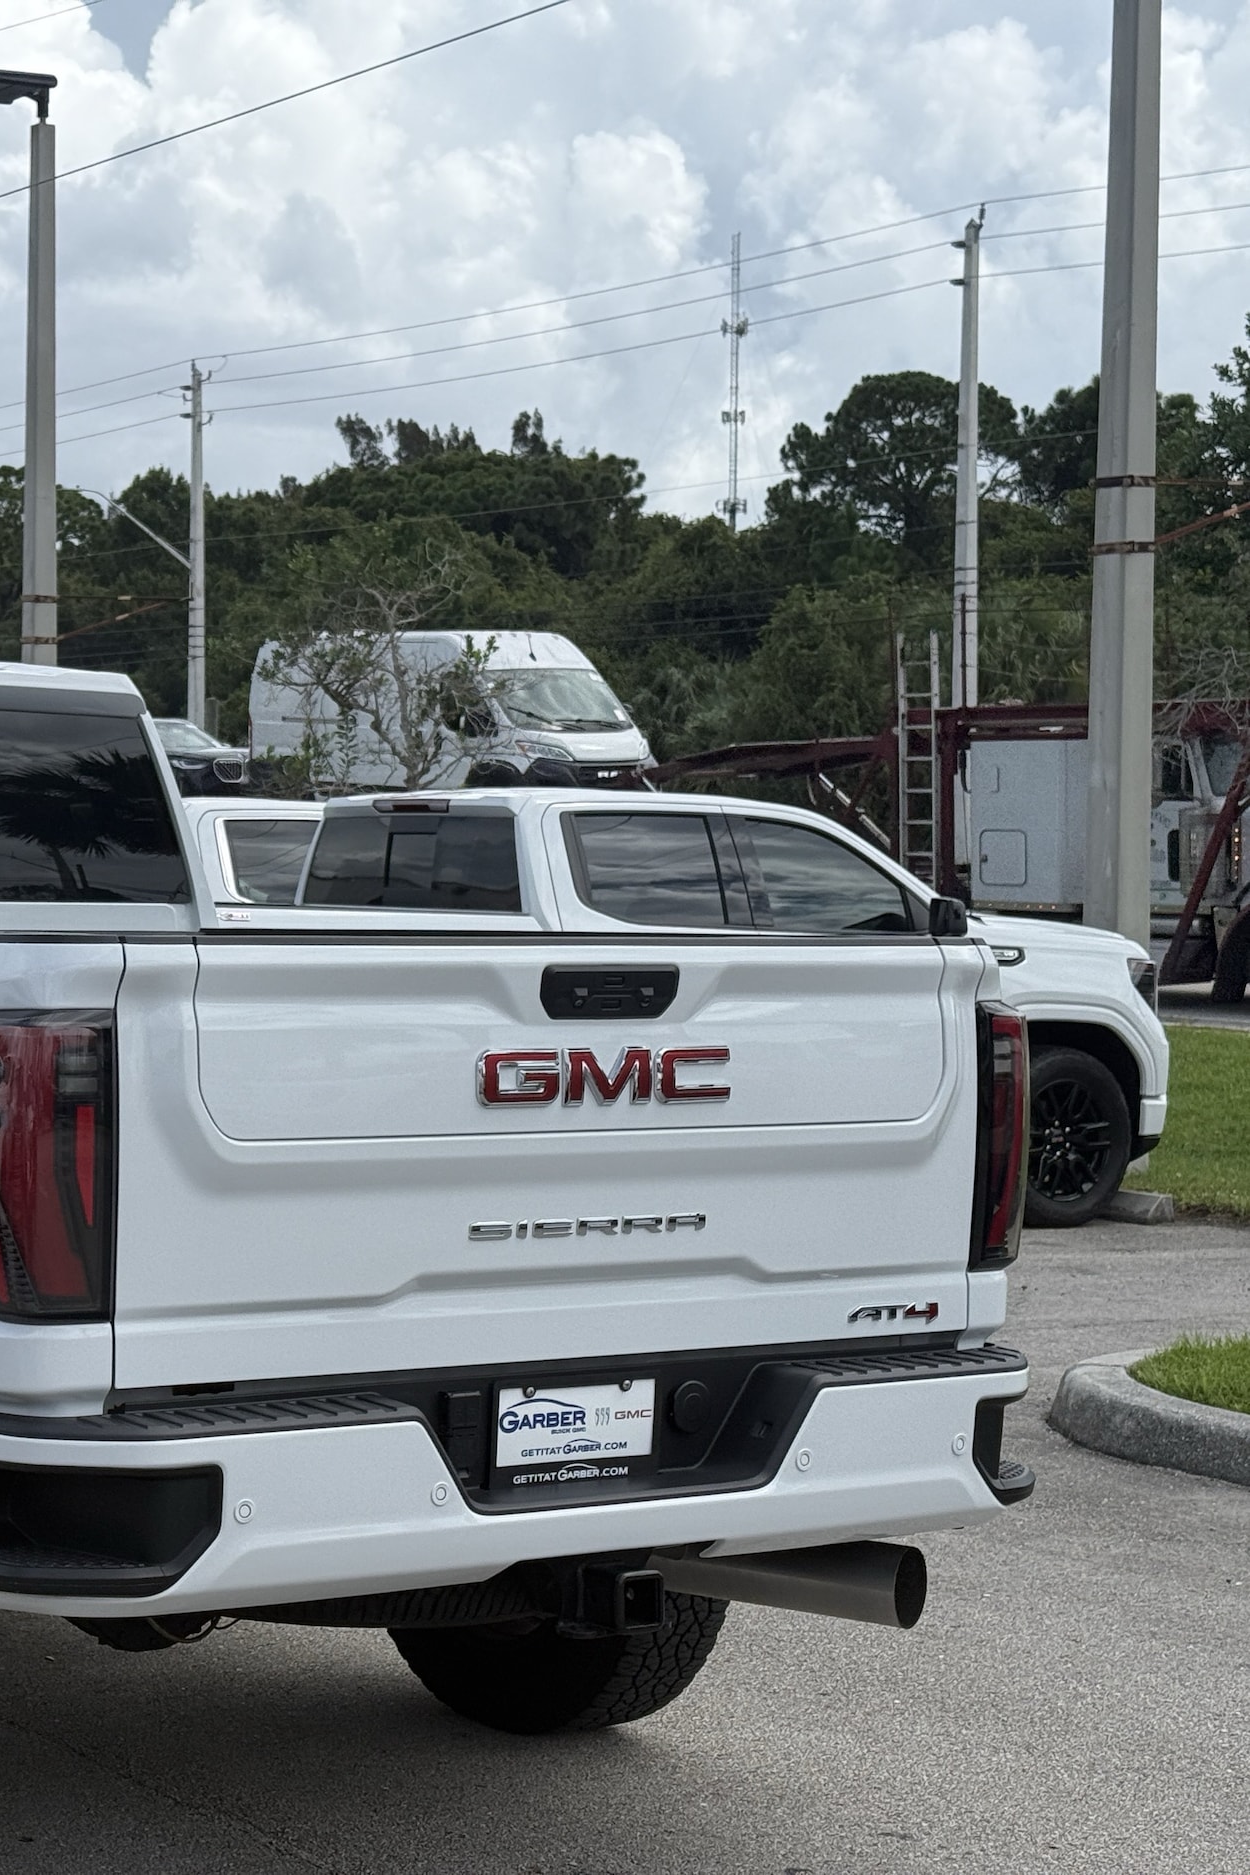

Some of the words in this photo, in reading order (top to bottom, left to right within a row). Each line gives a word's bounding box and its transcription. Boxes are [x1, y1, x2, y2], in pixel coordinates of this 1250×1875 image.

[475, 1045, 732, 1109] GMC
[468, 1212, 707, 1241] SIERRA
[847, 1301, 939, 1325] AT4
[499, 1410, 586, 1434] GARBER
[615, 1409, 652, 1420] GMC
